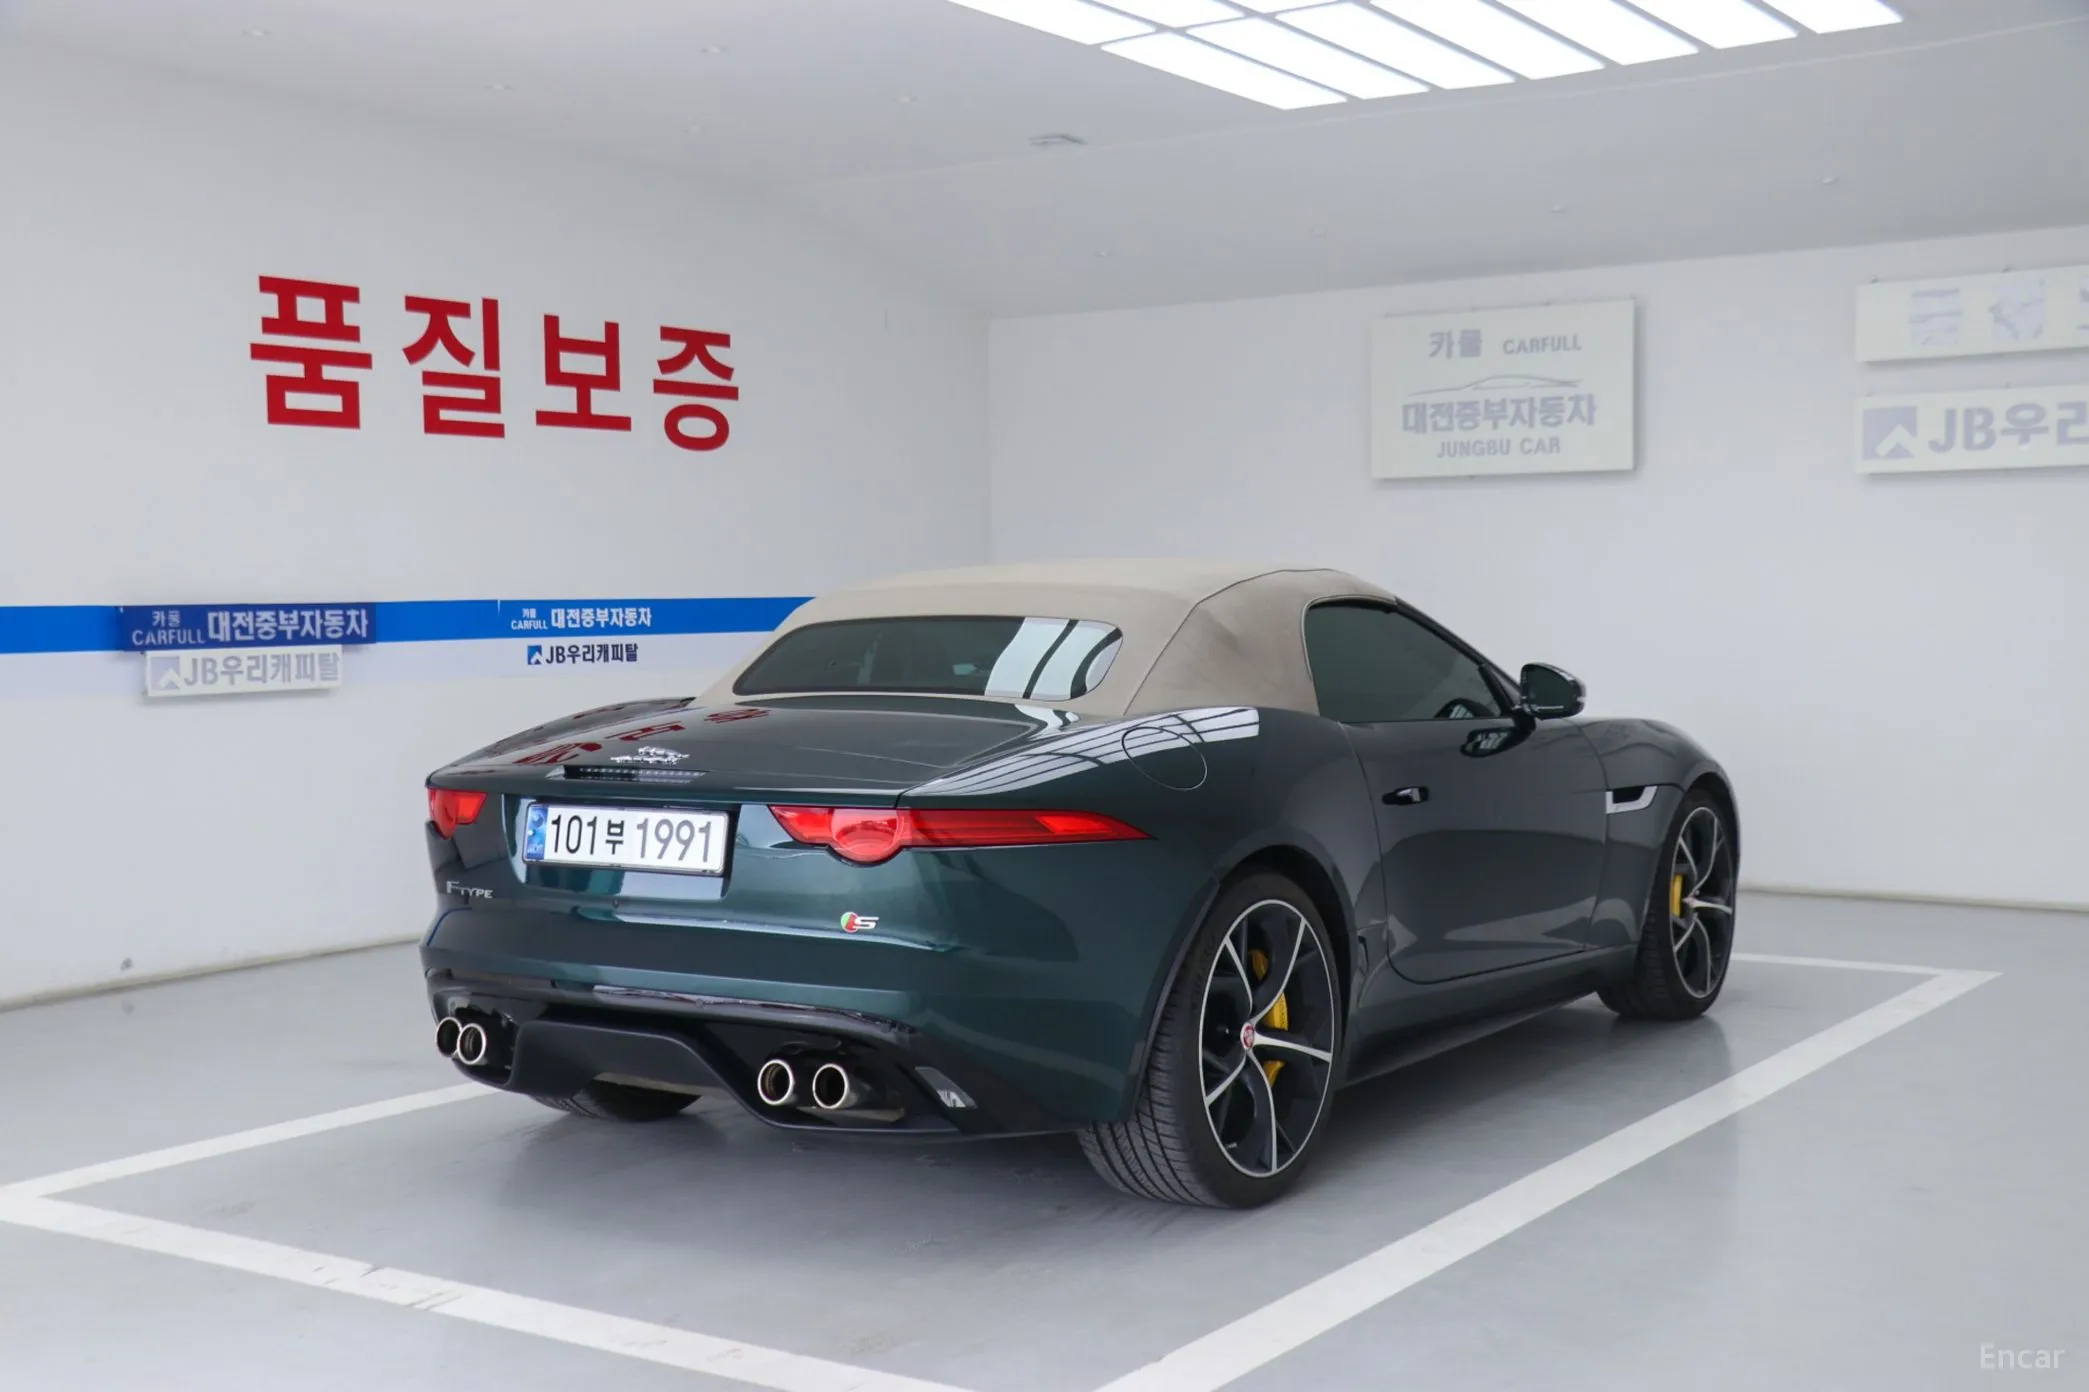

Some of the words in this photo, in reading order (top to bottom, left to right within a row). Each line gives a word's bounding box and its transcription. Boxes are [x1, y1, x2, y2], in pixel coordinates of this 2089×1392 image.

[1502, 334, 1583, 355] CARFULL
[1401, 393, 1597, 434] 대전중부자동차
[1436, 440, 1511, 459] JUNGBU
[1519, 436, 1562, 455] CAR
[207, 608, 369, 641] 대전중부자동차
[511, 619, 548, 631] CARFULL
[551, 607, 653, 629] 대전중부자동차
[131, 628, 205, 646] CARFULL
[545, 643, 639, 665] JB우리캐피탈
[184, 652, 340, 686] JB우리캐피탈
[551, 814, 625, 855] 101부
[636, 817, 712, 863] 1991
